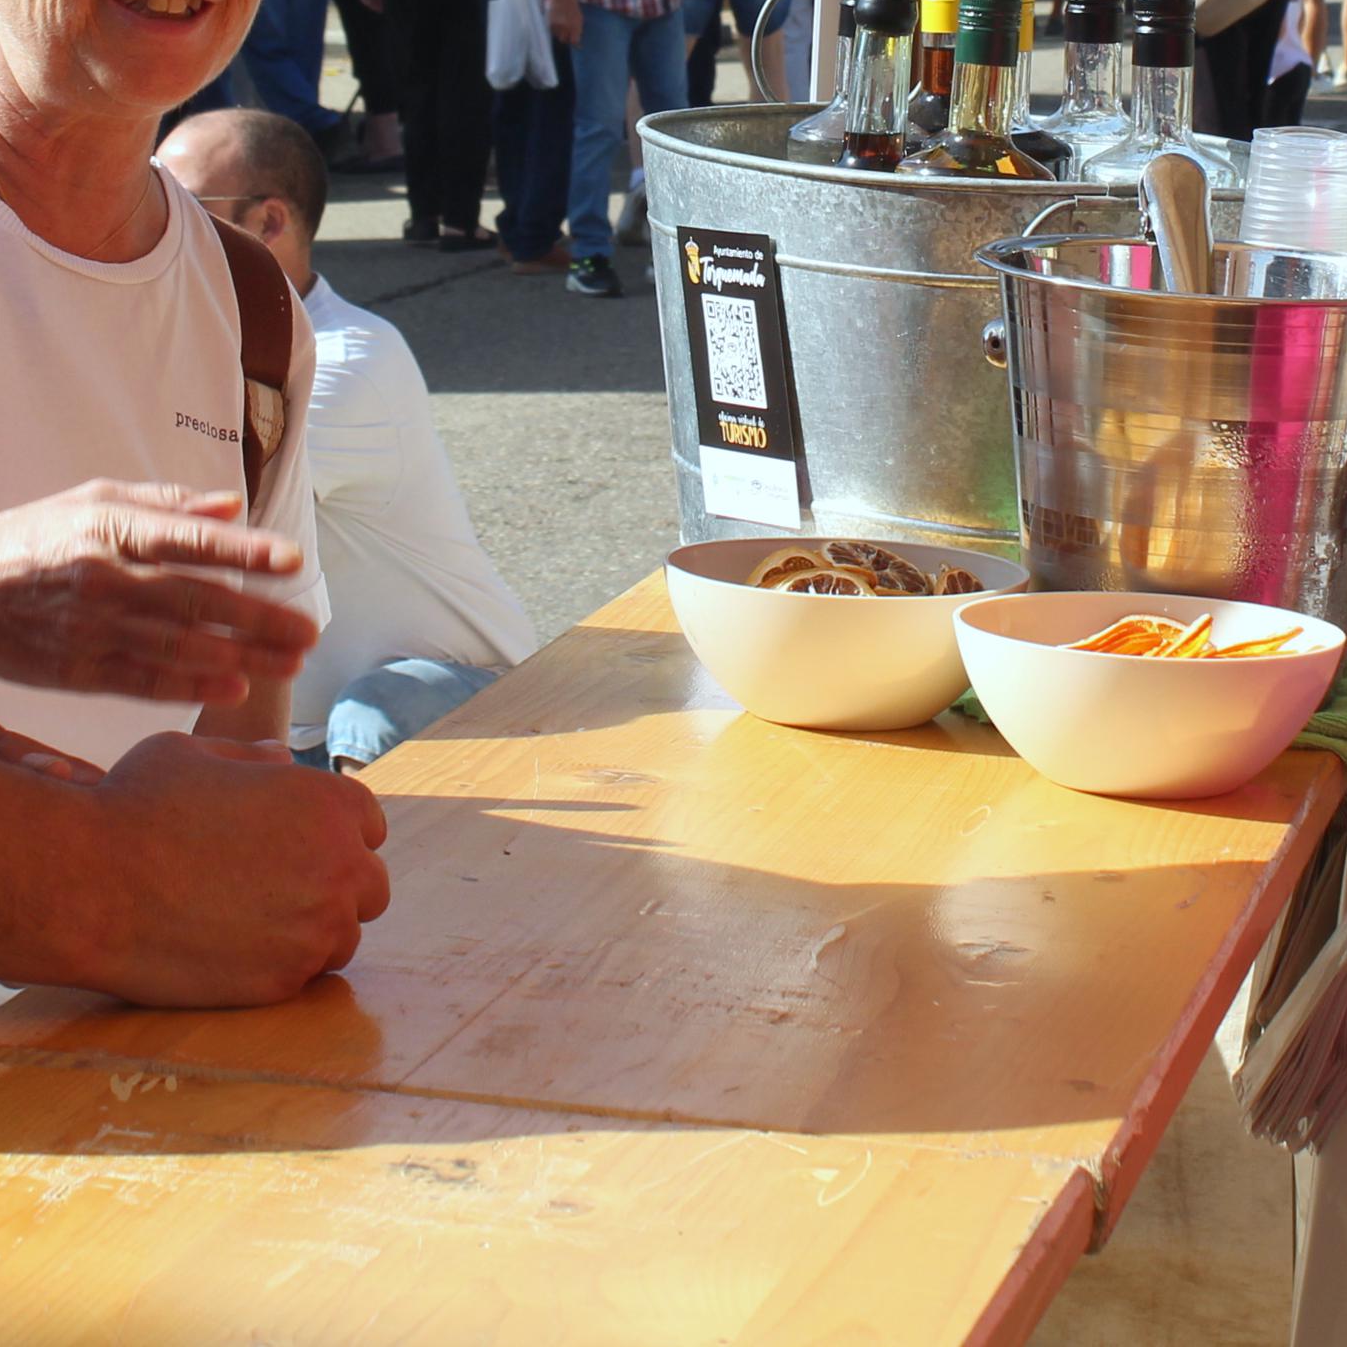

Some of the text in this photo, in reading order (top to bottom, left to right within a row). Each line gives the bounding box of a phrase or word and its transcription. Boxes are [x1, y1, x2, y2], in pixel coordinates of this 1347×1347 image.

[754, 249, 764, 261] de
[700, 256, 766, 292] Torquemada
[175, 412, 239, 443] preciosa
[719, 421, 767, 449] TURISMO
